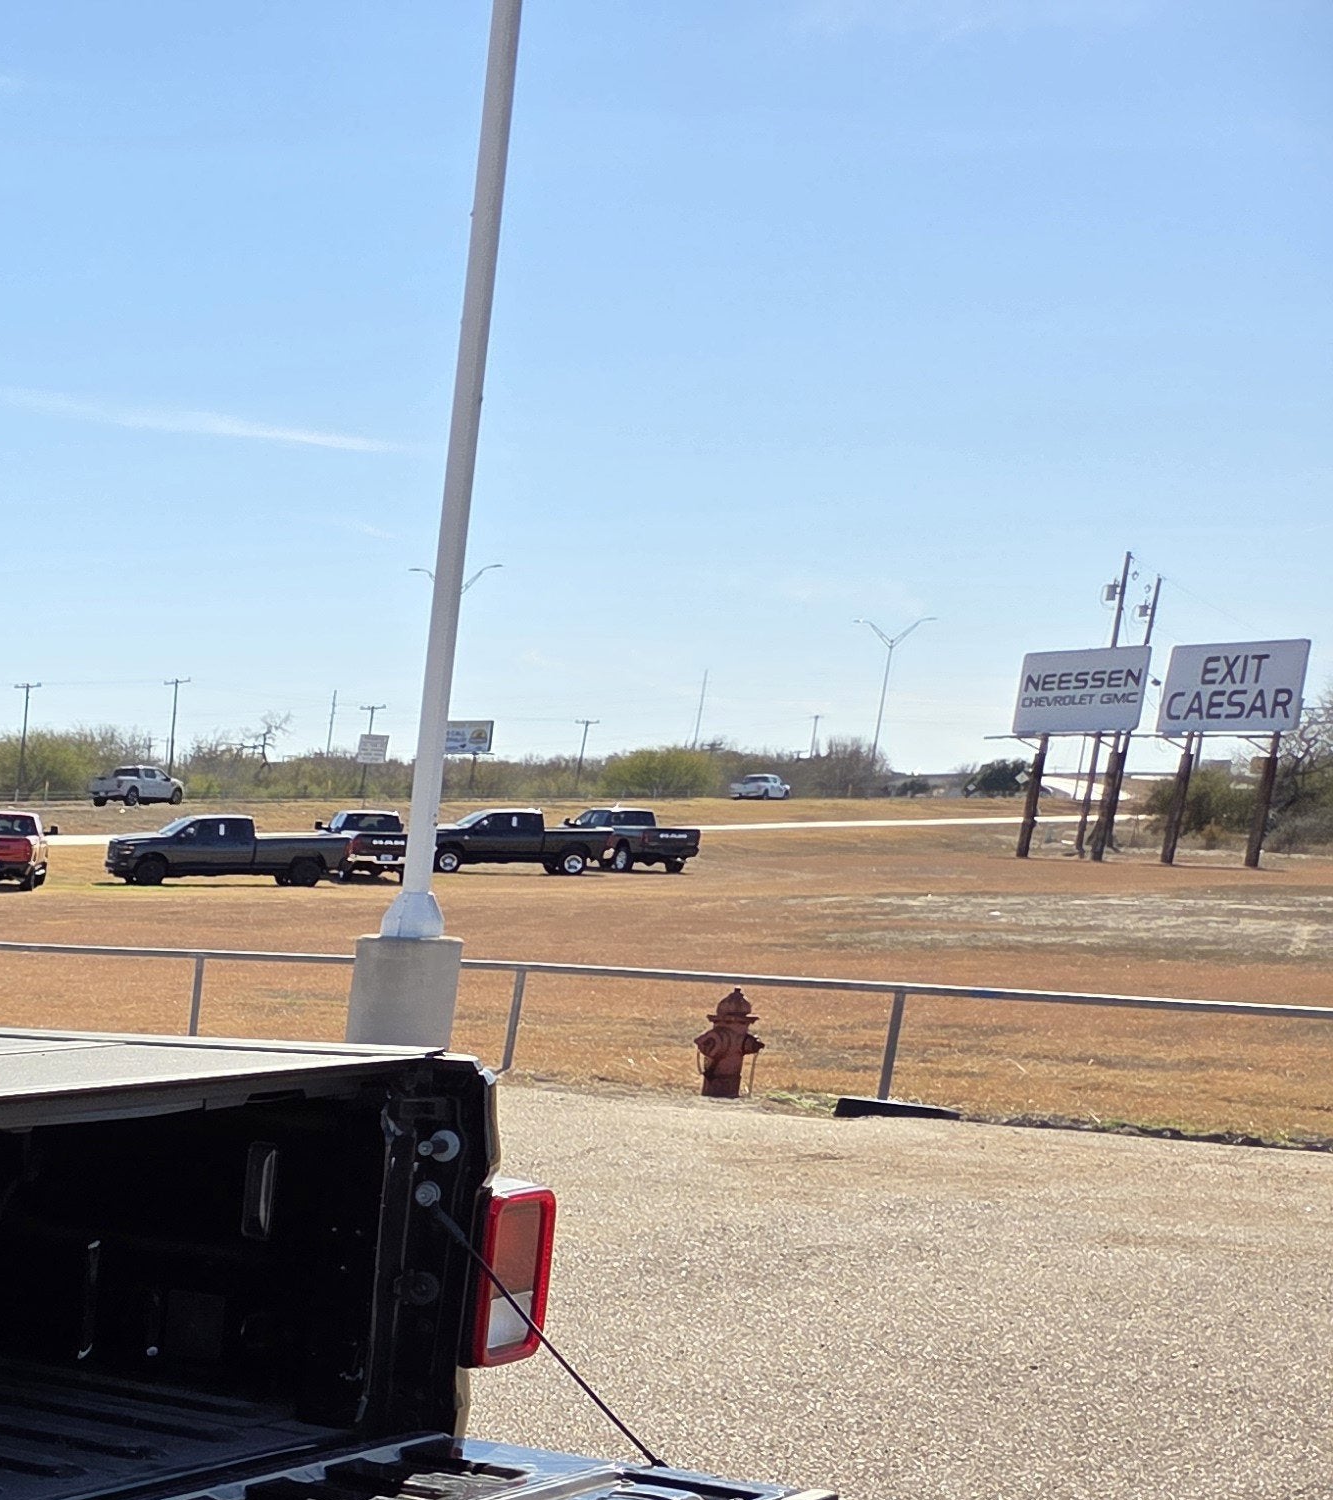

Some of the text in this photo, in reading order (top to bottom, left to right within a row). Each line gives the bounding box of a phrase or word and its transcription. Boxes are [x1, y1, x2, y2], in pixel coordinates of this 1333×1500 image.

[1024, 667, 1142, 692] NEESSEN
[1201, 654, 1270, 685] EXIT
[1021, 692, 1139, 708] CHEVROLET GMC
[1166, 688, 1293, 720] CAESAR
